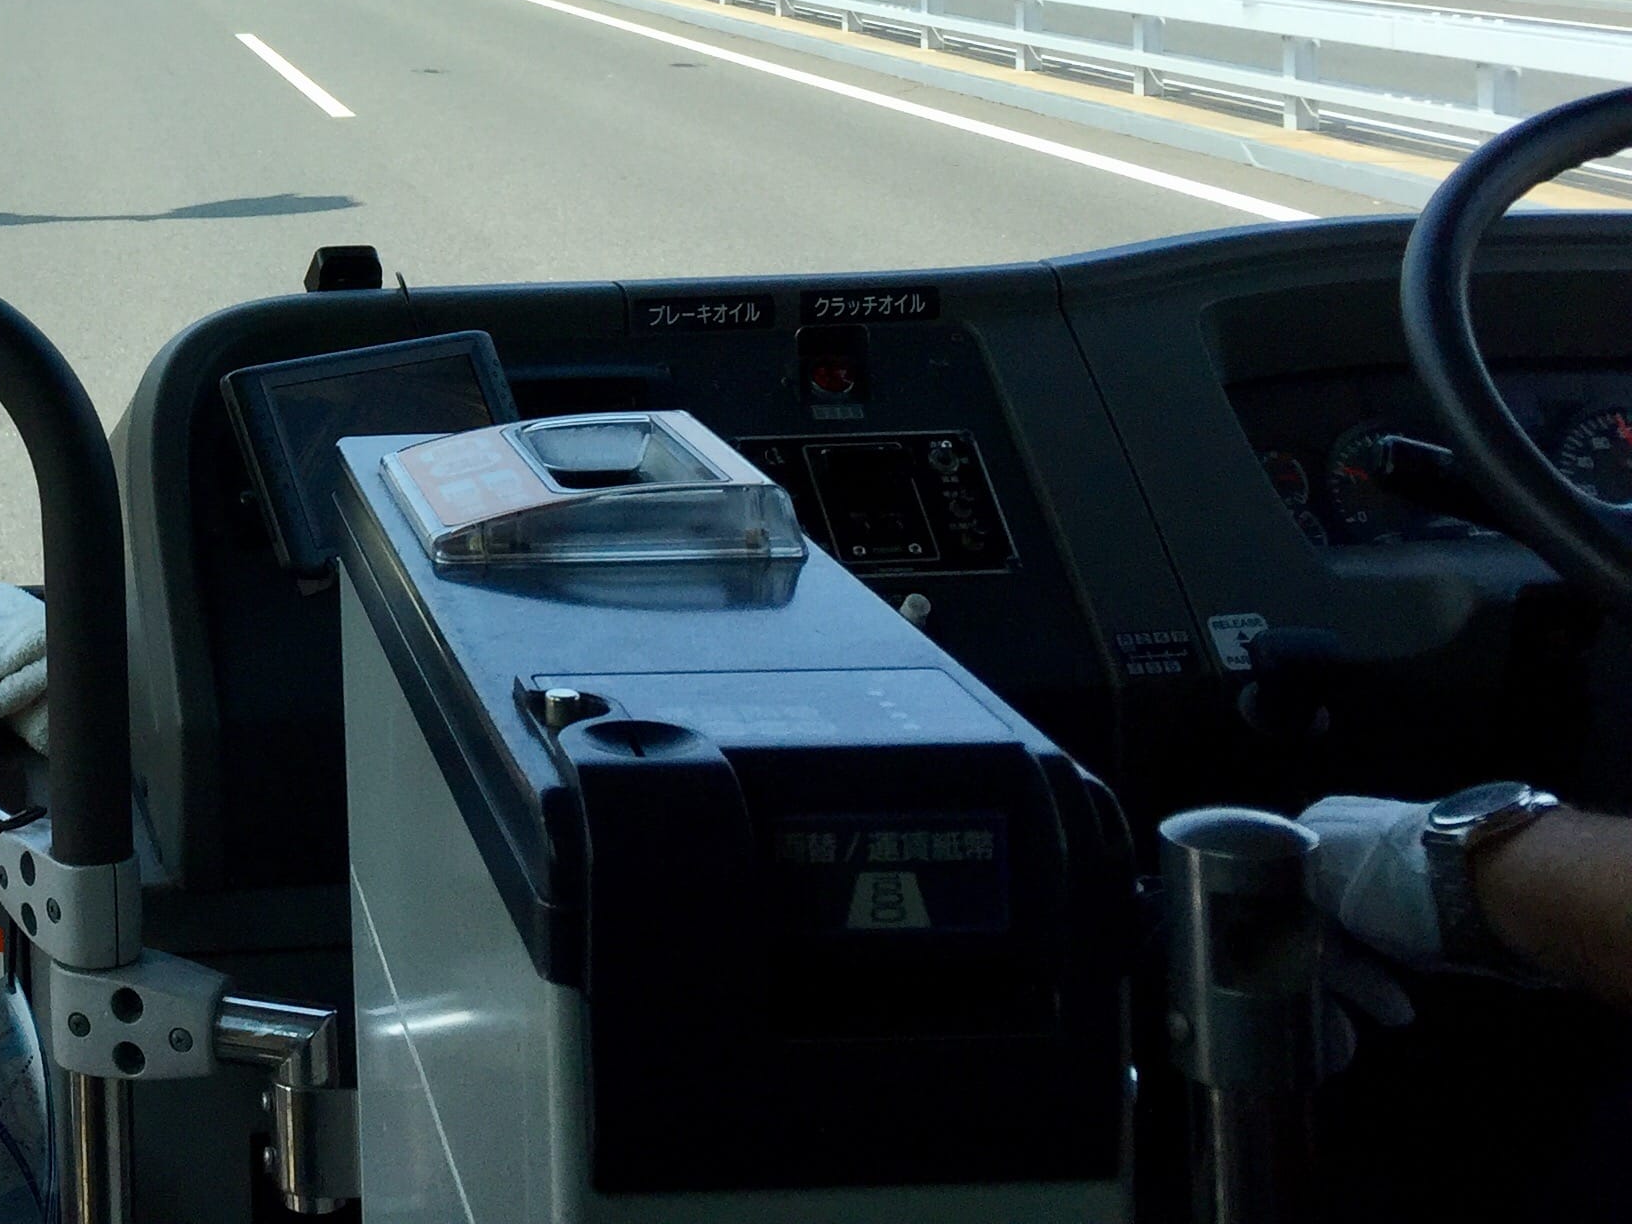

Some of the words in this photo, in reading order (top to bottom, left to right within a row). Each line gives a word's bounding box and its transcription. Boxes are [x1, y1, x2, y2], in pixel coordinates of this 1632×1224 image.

[648, 301, 761, 327] ブレーキオイル
[814, 293, 926, 318] クラッチオイル
[1226, 656, 1250, 666] PAR
